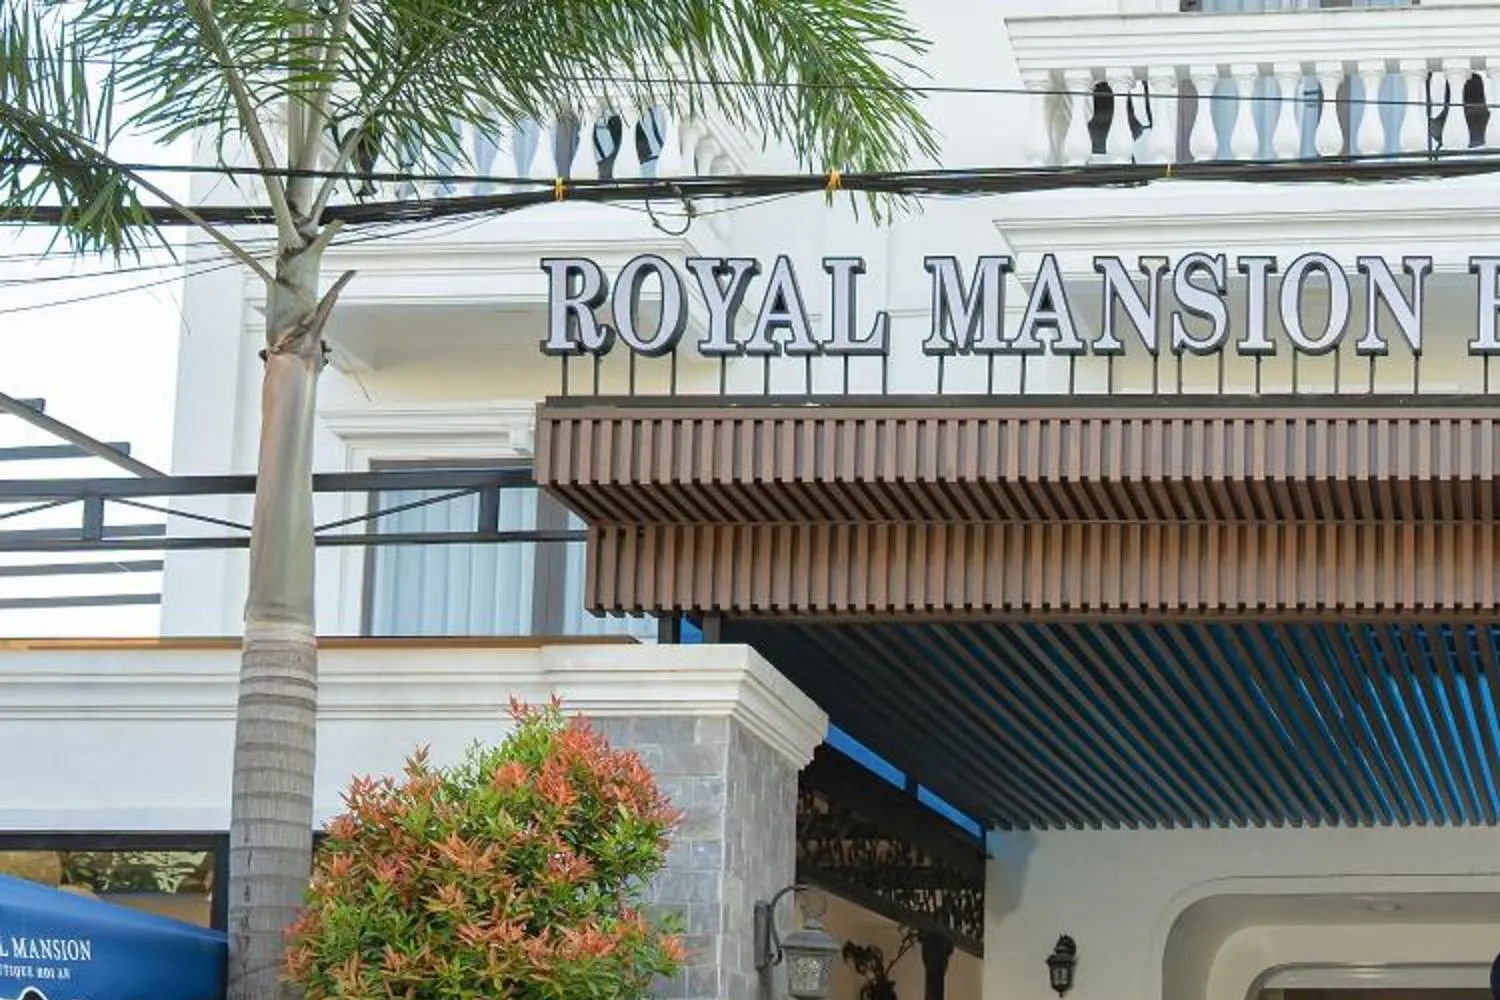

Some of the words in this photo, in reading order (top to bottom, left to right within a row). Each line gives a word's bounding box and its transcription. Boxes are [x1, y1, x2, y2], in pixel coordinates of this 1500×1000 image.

[540, 254, 890, 356] ROYAL
[922, 252, 1432, 356] MANSION
[11, 936, 92, 961] MANSION
